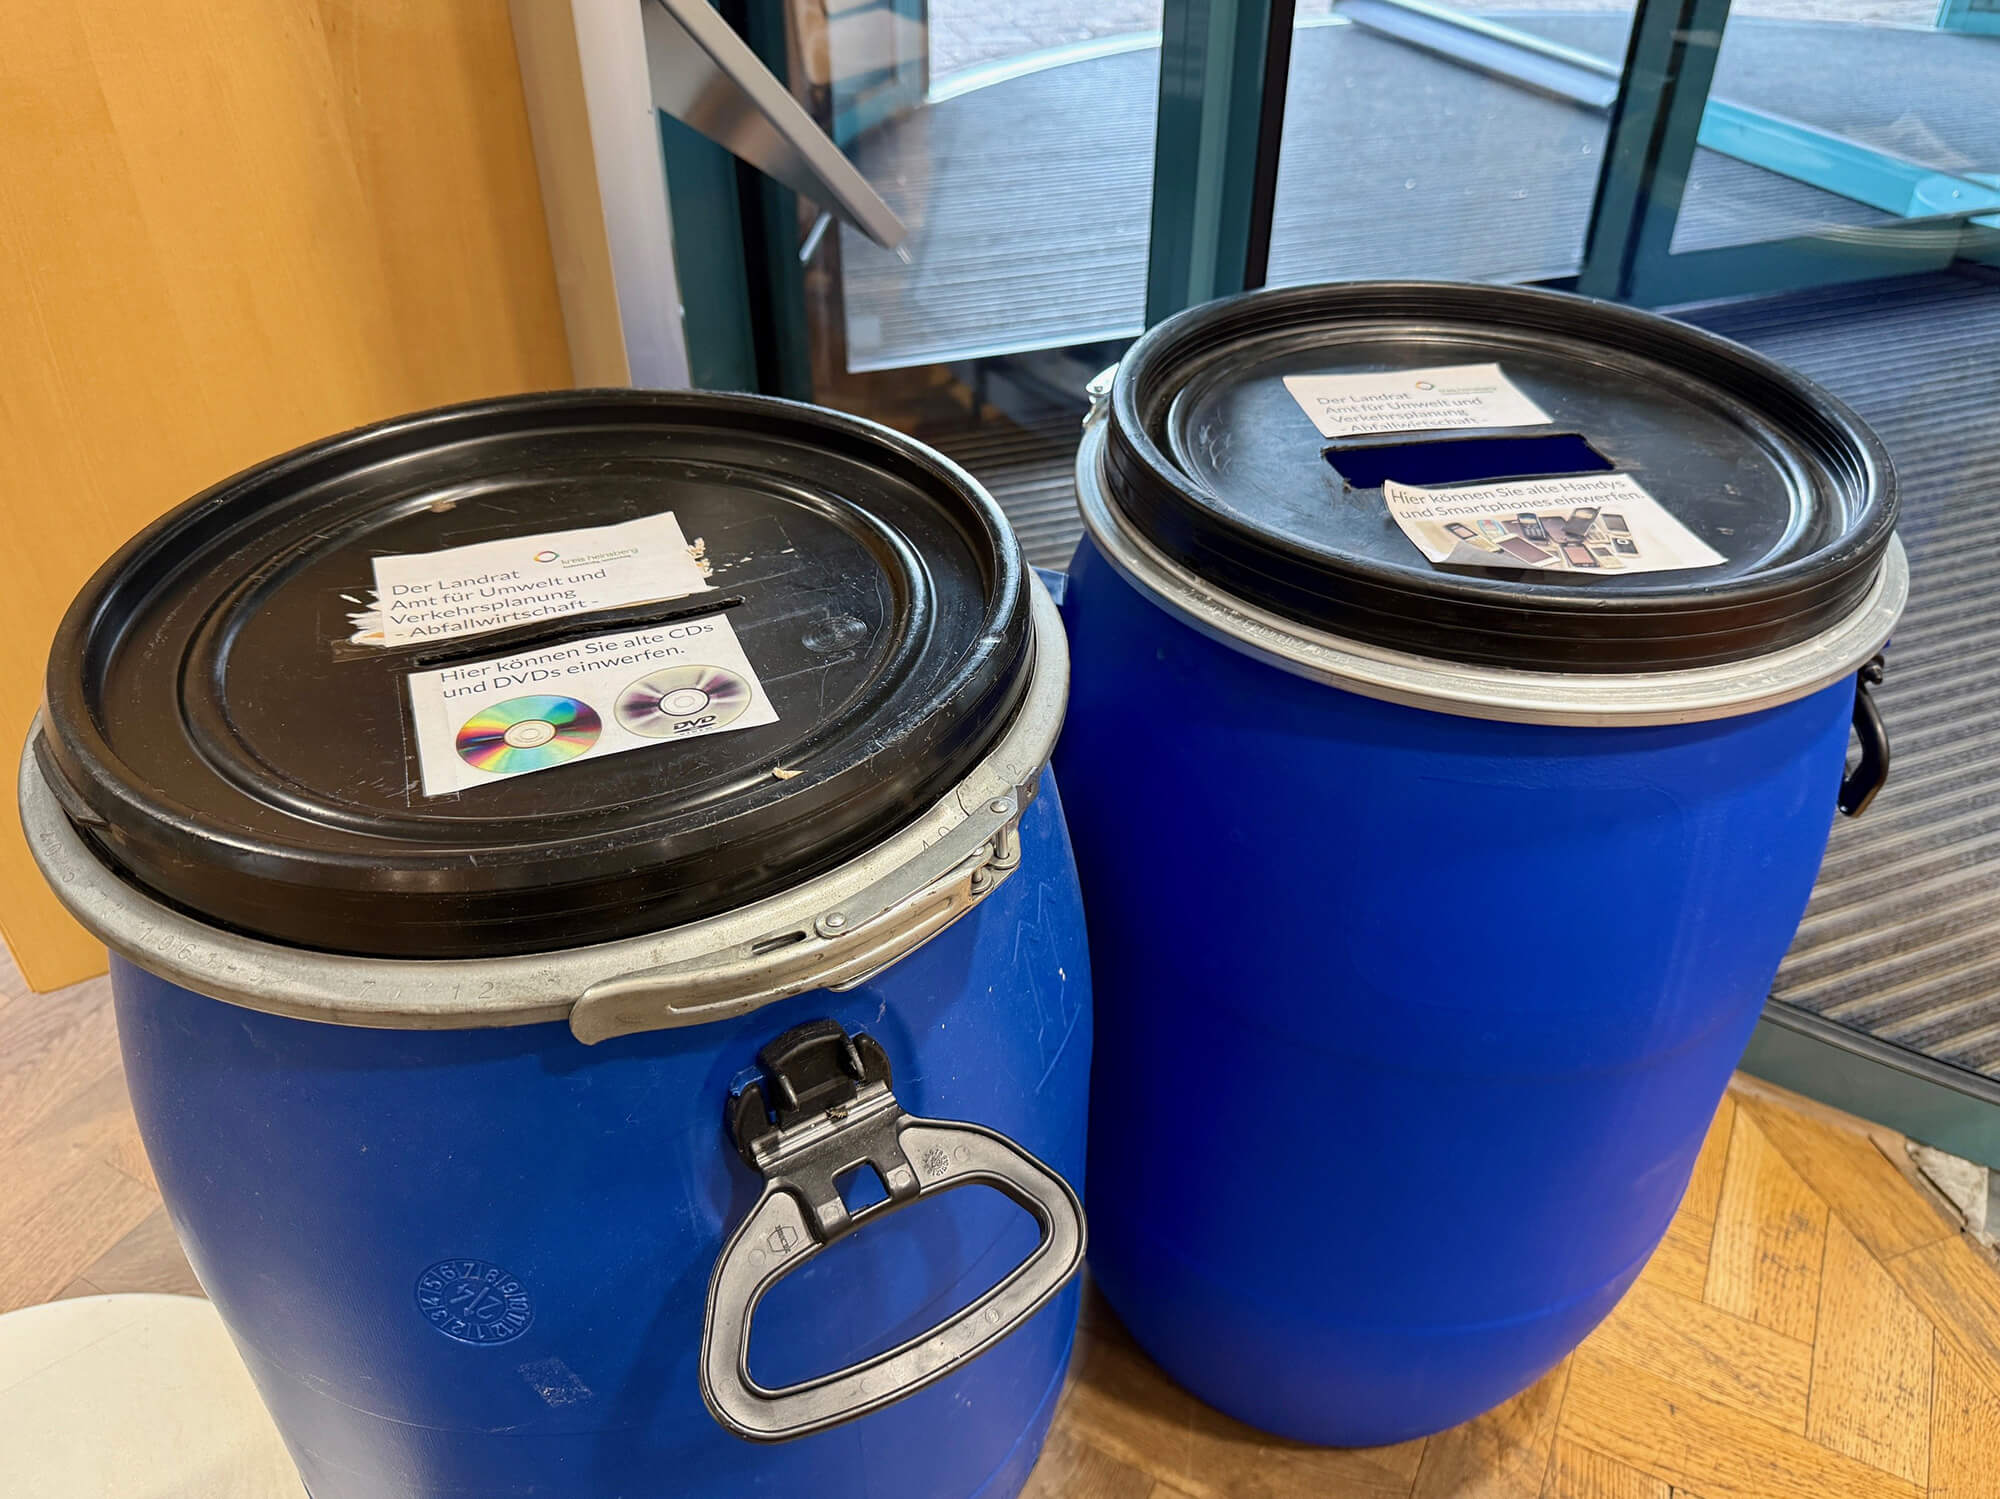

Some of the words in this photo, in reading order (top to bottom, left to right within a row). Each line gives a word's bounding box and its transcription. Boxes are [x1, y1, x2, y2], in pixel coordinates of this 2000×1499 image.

[1316, 396, 1347, 406] Der
[1350, 392, 1410, 402] Landrat
[1325, 403, 1361, 415] Amt
[1362, 401, 1386, 412] für
[1387, 399, 1450, 411] Umwelt
[1453, 397, 1483, 406] und
[1330, 409, 1470, 424] Verkehrsplanung
[1351, 416, 1478, 433] Abfallwirtschaft
[1391, 489, 1425, 505] Hier
[1428, 488, 1491, 504] können
[1498, 486, 1525, 498] Sie
[1528, 484, 1559, 496] alte
[1561, 479, 1625, 493] Handys
[1400, 508, 1432, 520] und
[1435, 498, 1552, 519] Smartphones
[1552, 490, 1646, 506] einwerfen.
[391, 596, 437, 611] Amt
[442, 590, 474, 606] für
[480, 576, 564, 600] Umwelt
[567, 568, 607, 585] und
[392, 582, 432, 596] Der
[438, 569, 520, 592] Landrat
[390, 589, 577, 625] Verkehrsplanung
[410, 599, 587, 639] Abfallwirtschaft
[441, 666, 490, 683] Hier
[497, 649, 580, 673] können
[585, 640, 619, 655] Sie
[624, 633, 664, 650] alte
[668, 623, 714, 640] CDs
[443, 681, 487, 699] und
[493, 668, 561, 689] DVDs
[567, 645, 686, 674] einwerfen.
[674, 715, 716, 730] DVD
